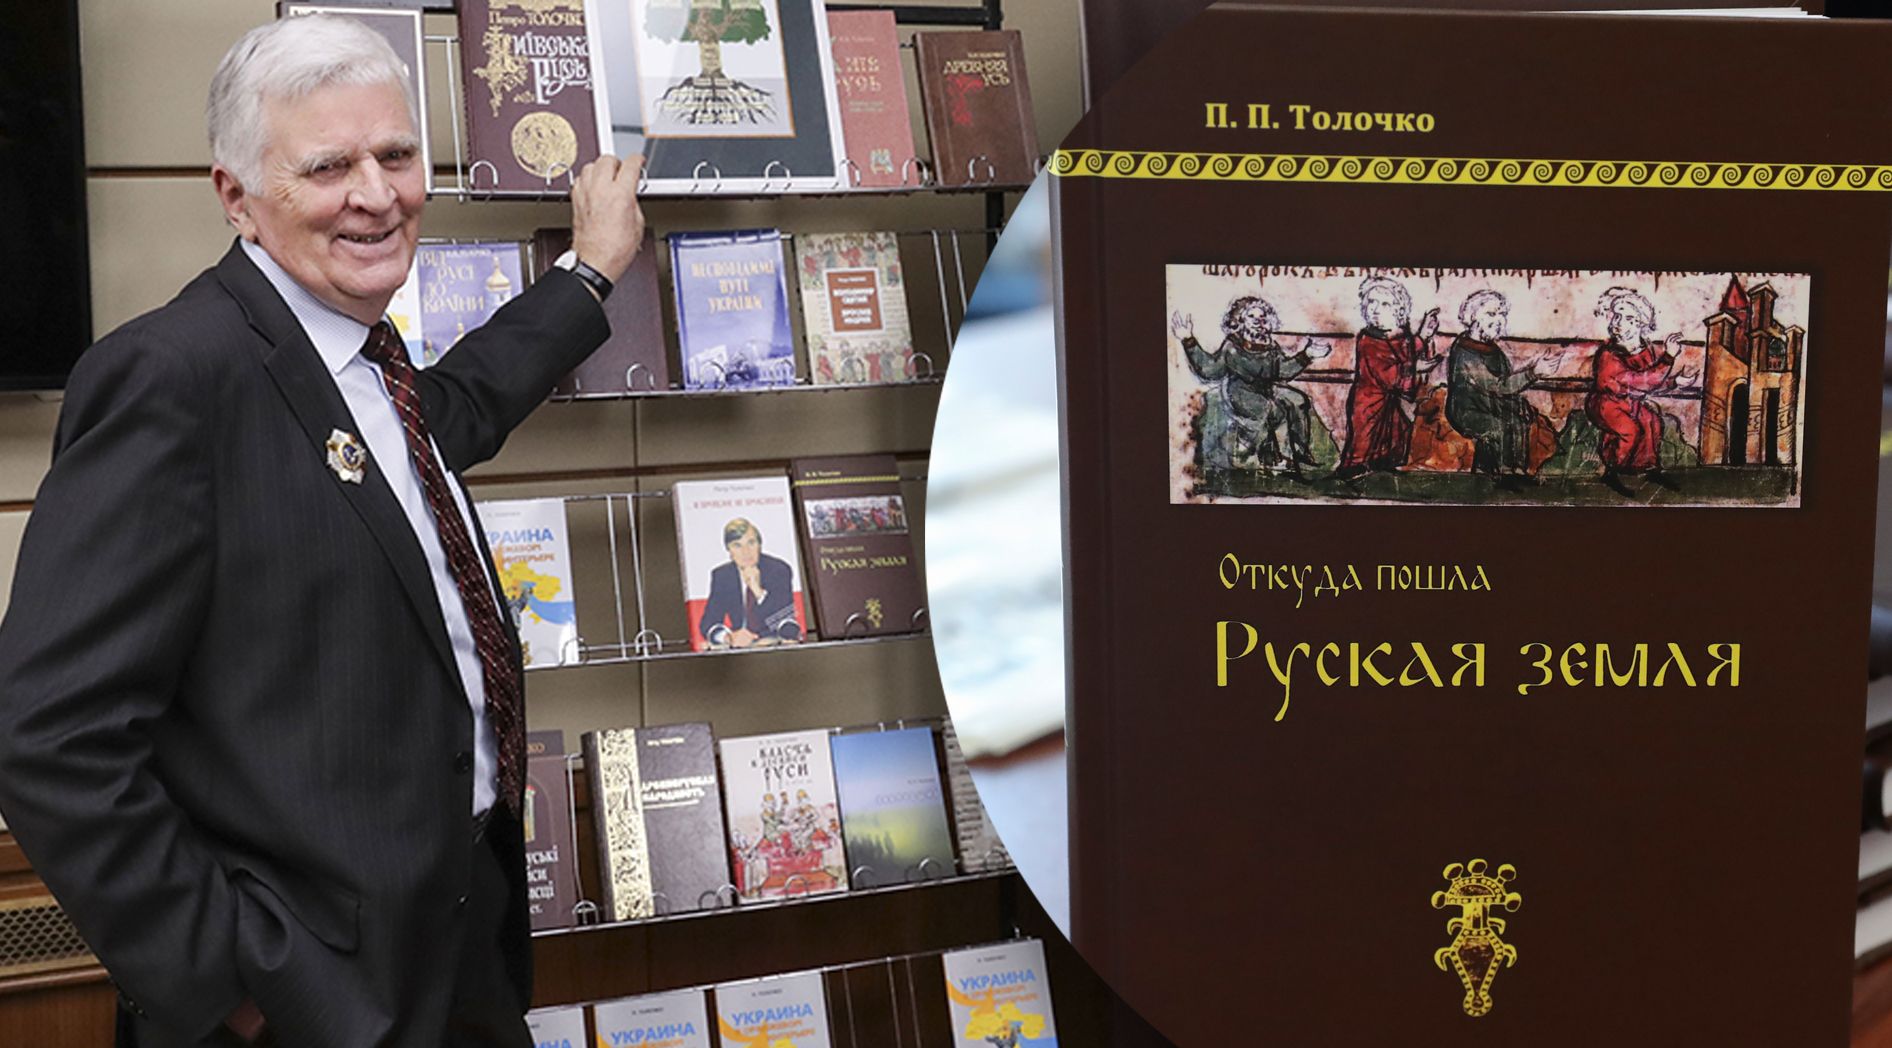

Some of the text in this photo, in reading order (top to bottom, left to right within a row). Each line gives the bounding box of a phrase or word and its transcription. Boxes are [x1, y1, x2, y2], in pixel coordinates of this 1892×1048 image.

[489, 11, 585, 28] Петро ТОЛОЧК
[529, 57, 594, 105] РУСЬ
[1207, 102, 1435, 132] П. П. Толочко
[484, 528, 555, 545] РАИНА
[1220, 553, 1490, 608] Откуда пошла
[1216, 621, 1740, 721] Руская земля
[526, 845, 559, 870] УСЬКІ
[960, 968, 1036, 991] УКРАИНА
[732, 1002, 814, 1027] УКРАИНА
[611, 1022, 696, 1046] УКРАИНА
